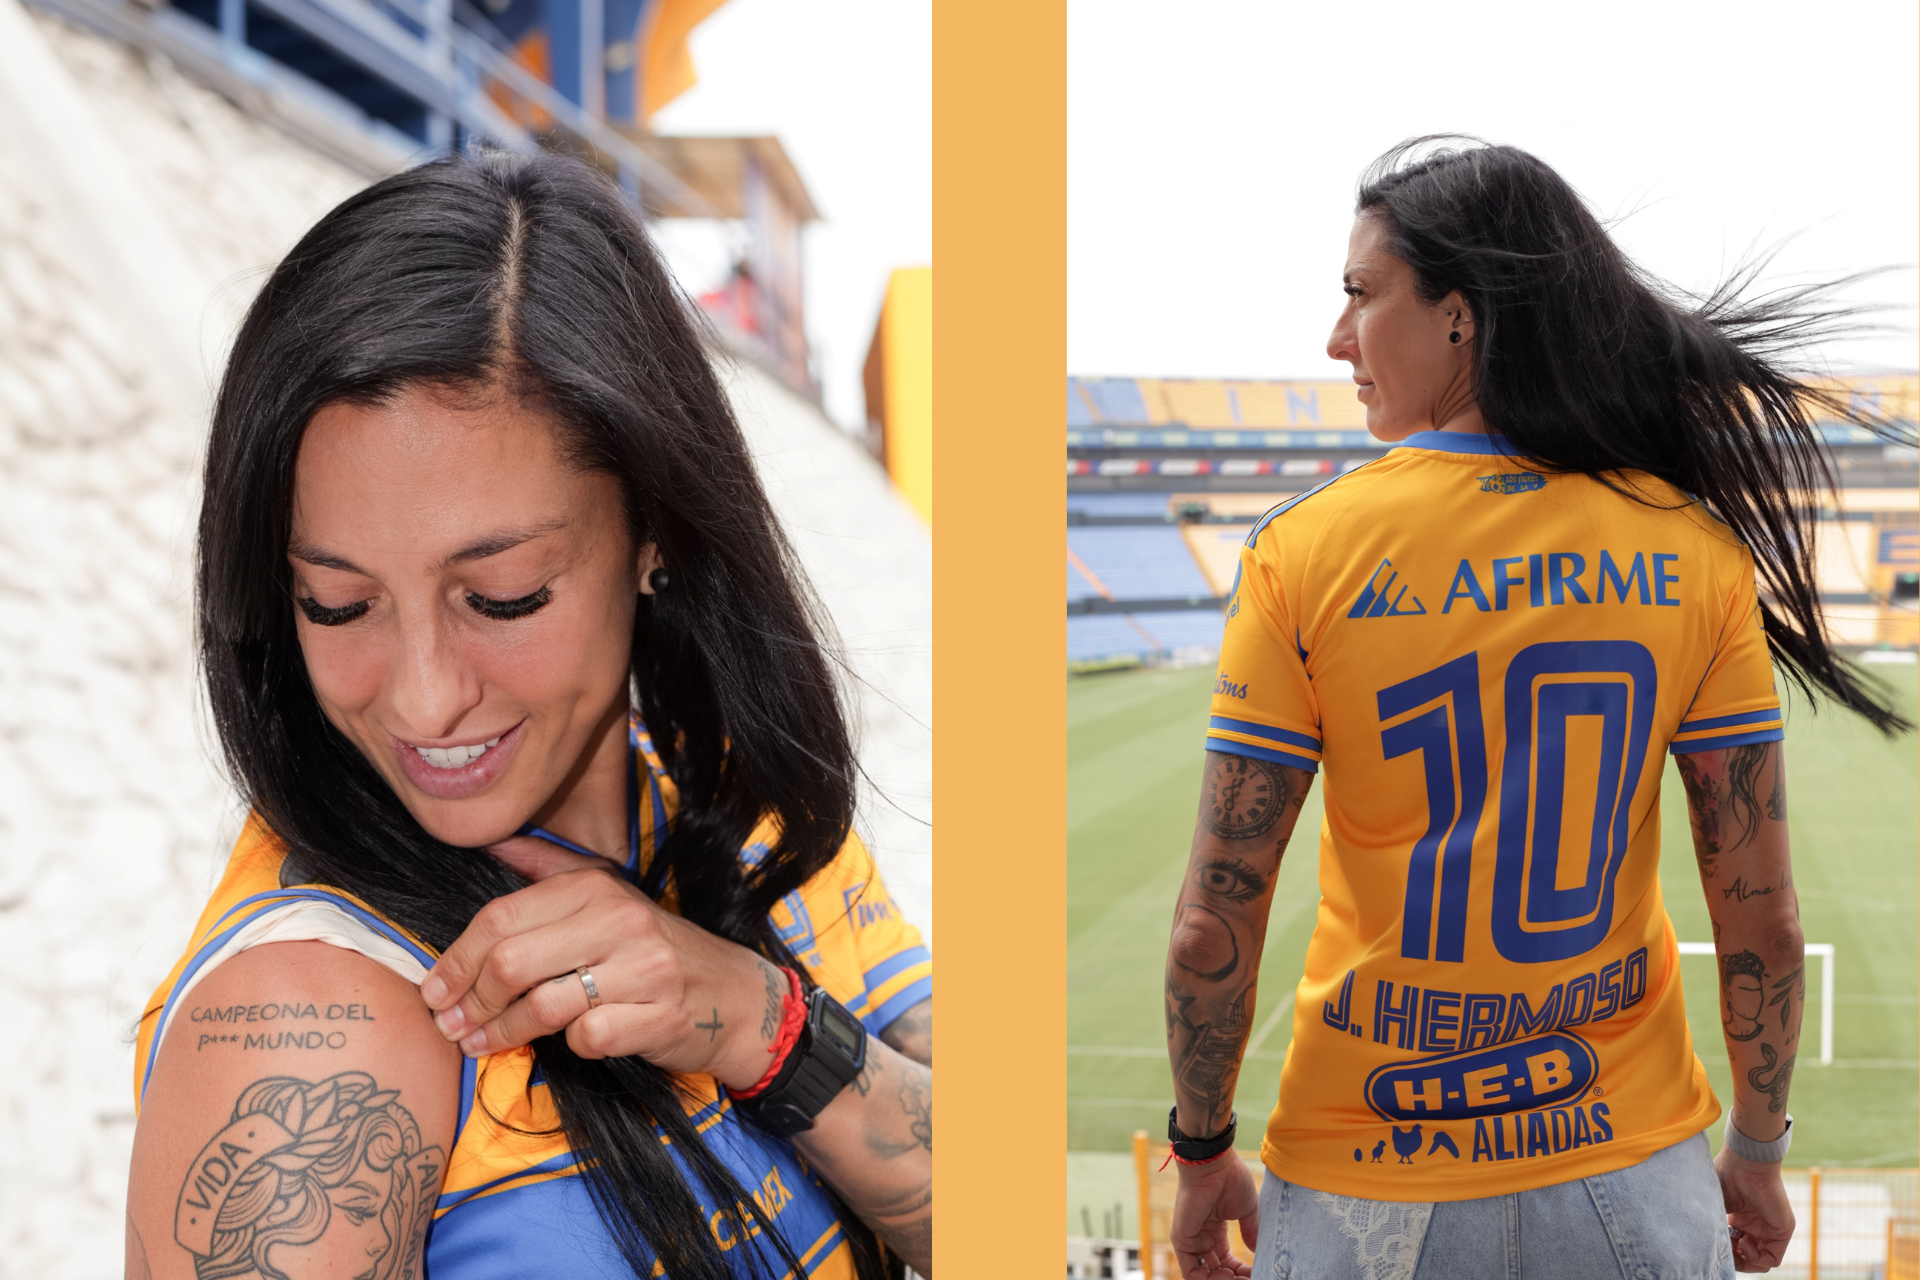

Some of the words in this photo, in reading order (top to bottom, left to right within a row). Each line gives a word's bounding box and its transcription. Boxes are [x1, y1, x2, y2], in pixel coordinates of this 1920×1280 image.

[1441, 549, 1680, 614] AFIRME
[1376, 639, 1658, 964] 10
[1722, 876, 1775, 902] Alma
[190, 1003, 319, 1023] CAMPEONA
[325, 1003, 375, 1021] DEL
[244, 1031, 347, 1050] MUNDO
[1471, 1102, 1614, 1163] ALIADAS
[186, 1141, 251, 1210] VIDA
